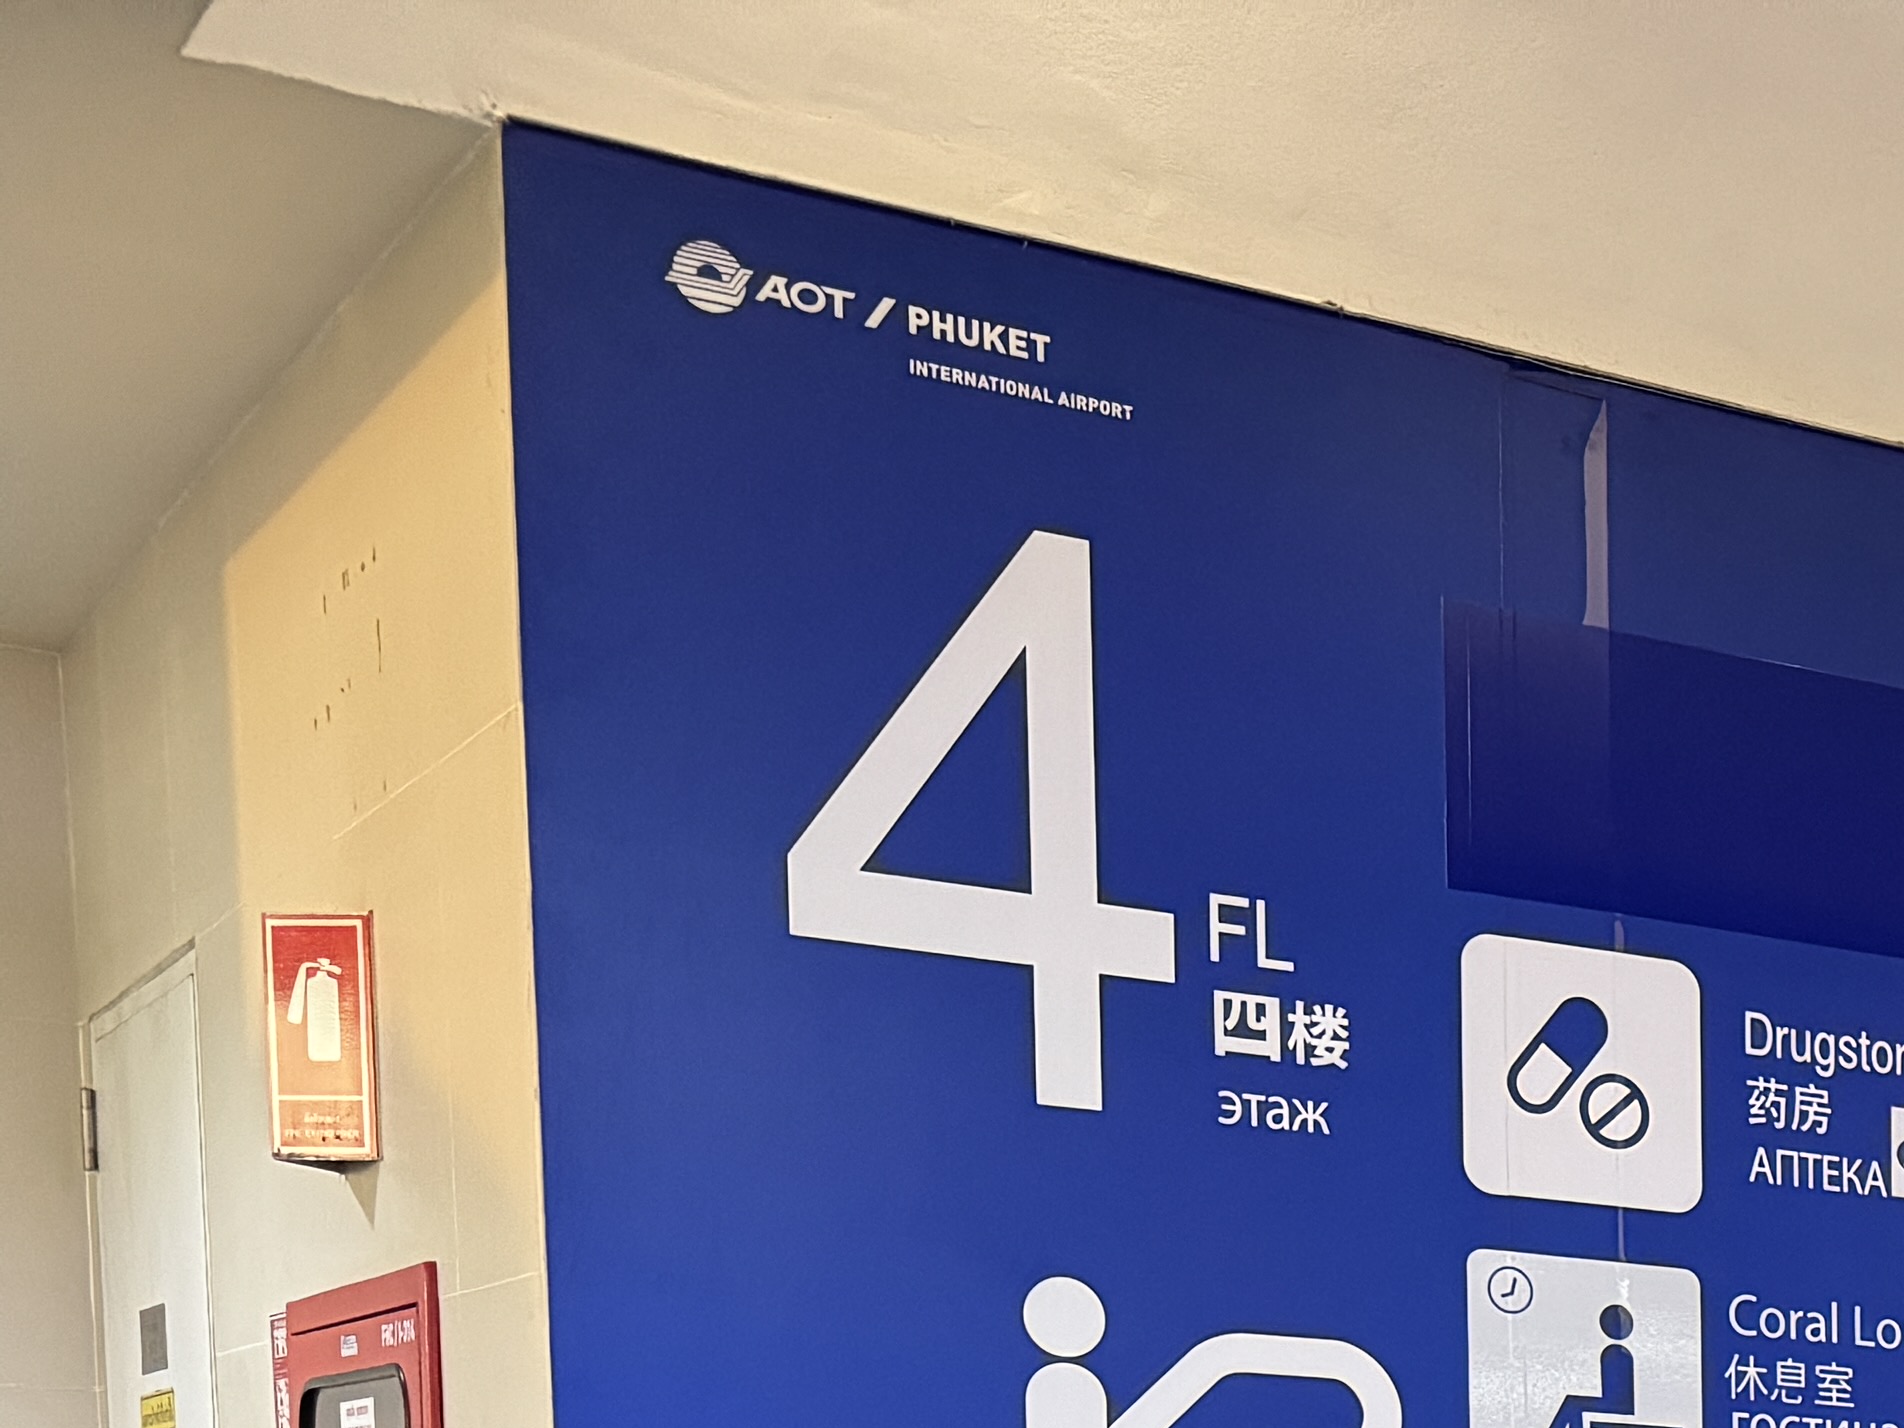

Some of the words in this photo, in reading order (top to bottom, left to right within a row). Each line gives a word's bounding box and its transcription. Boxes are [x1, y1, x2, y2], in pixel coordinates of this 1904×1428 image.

[755, 274, 855, 320] AOT
[907, 307, 1050, 364] PHUKET
[909, 359, 1053, 405] INTERNATIONAL
[1058, 390, 1134, 421] AIRPORT
[787, 529, 1176, 1113] 4
[1209, 892, 1295, 972] FL
[1213, 990, 1350, 1070] 四楼
[1217, 1090, 1331, 1135] этаж
[1746, 1076, 1832, 1135] 药房
[1749, 1146, 1887, 1197] АПТЕКА
[1728, 1294, 1838, 1344] Coral
[1724, 1355, 1855, 1409] 休息室
